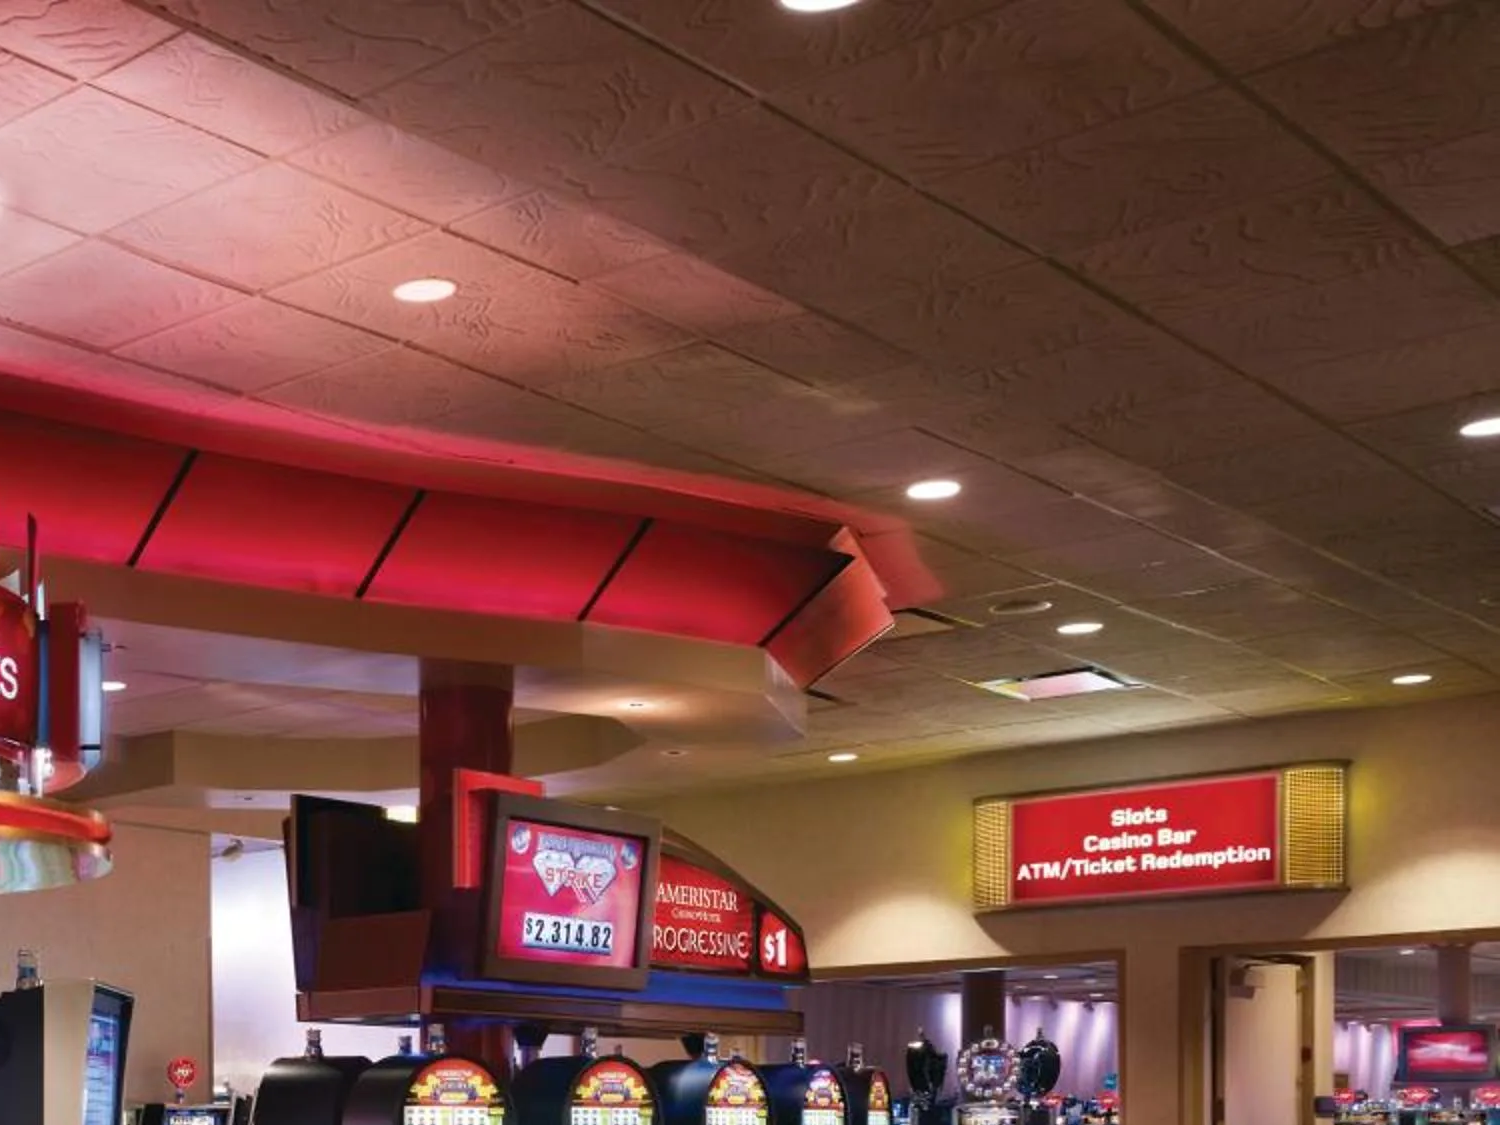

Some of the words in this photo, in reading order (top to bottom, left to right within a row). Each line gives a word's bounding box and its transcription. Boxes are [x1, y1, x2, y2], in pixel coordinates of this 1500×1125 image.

[1111, 807, 1168, 827] Slots
[1083, 832, 1153, 853] Casino
[1157, 827, 1197, 846] Bar
[544, 866, 604, 889] STRIKE
[1017, 854, 1137, 881] ATM/Ticket
[1141, 845, 1271, 870] Redemption
[655, 881, 739, 912] AMERISTAR
[653, 924, 749, 959] ROGRESSIVE
[764, 928, 787, 966] $1
